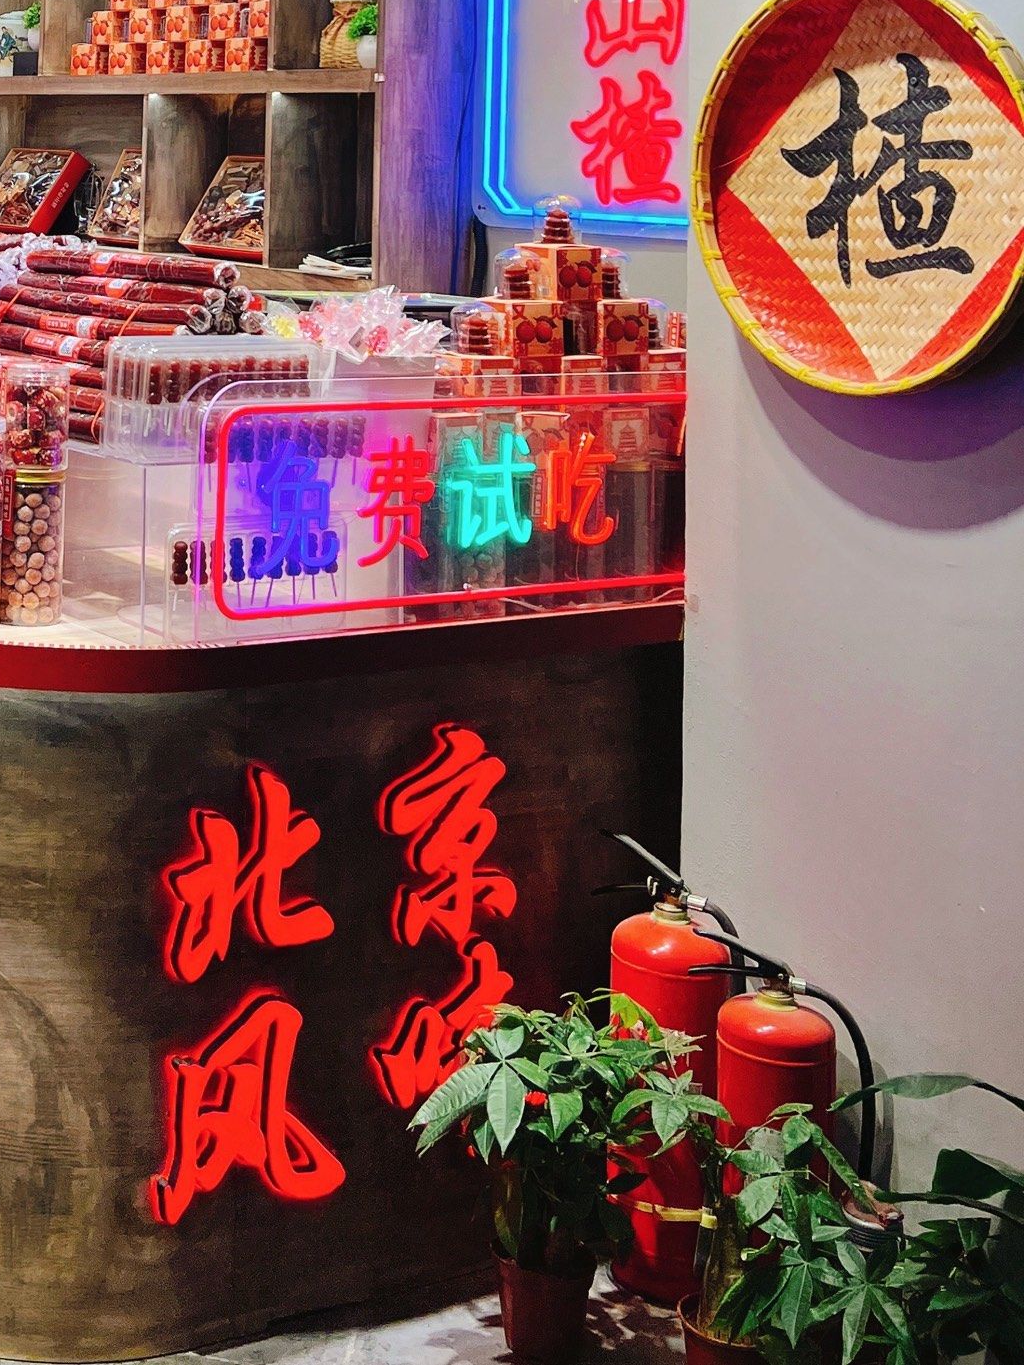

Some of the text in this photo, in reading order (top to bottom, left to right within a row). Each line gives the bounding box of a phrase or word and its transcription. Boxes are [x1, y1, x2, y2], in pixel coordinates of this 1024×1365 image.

[779, 51, 976, 291] 楂
[253, 421, 617, 576] 免费试吃
[164, 722, 518, 984] 北京
